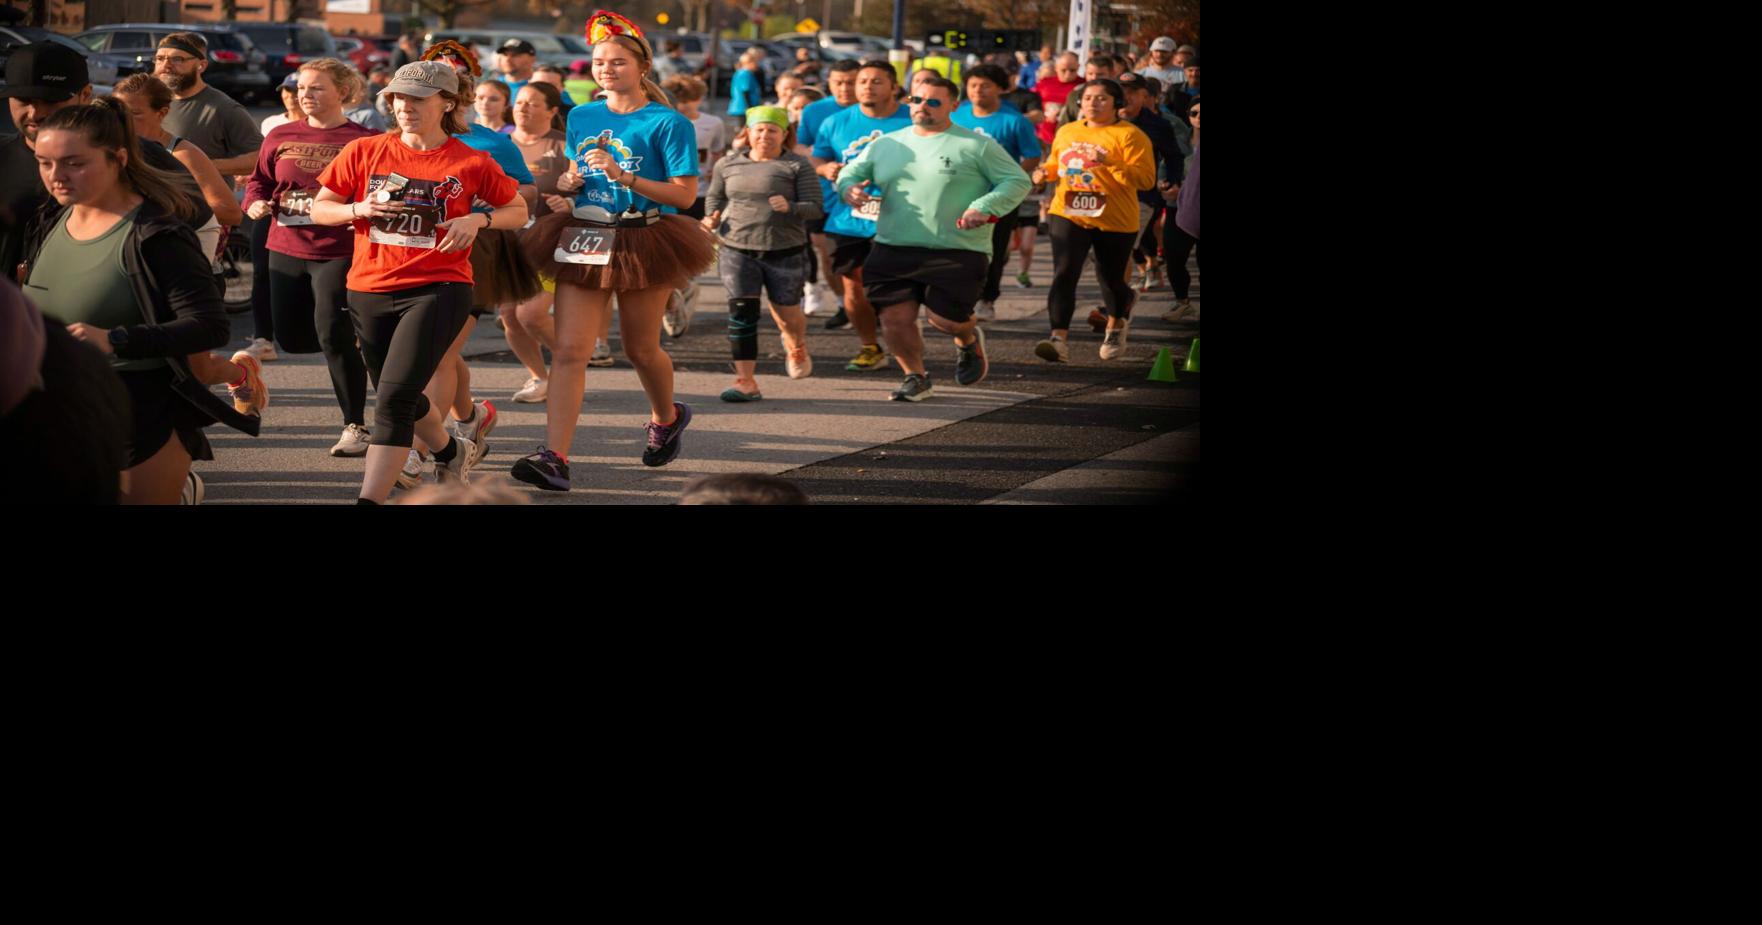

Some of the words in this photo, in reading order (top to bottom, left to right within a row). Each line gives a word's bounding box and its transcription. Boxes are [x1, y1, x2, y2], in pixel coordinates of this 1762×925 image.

[287, 198, 313, 215] 713
[1072, 195, 1097, 209] 600
[384, 213, 423, 235] 720
[570, 236, 604, 253] 647
